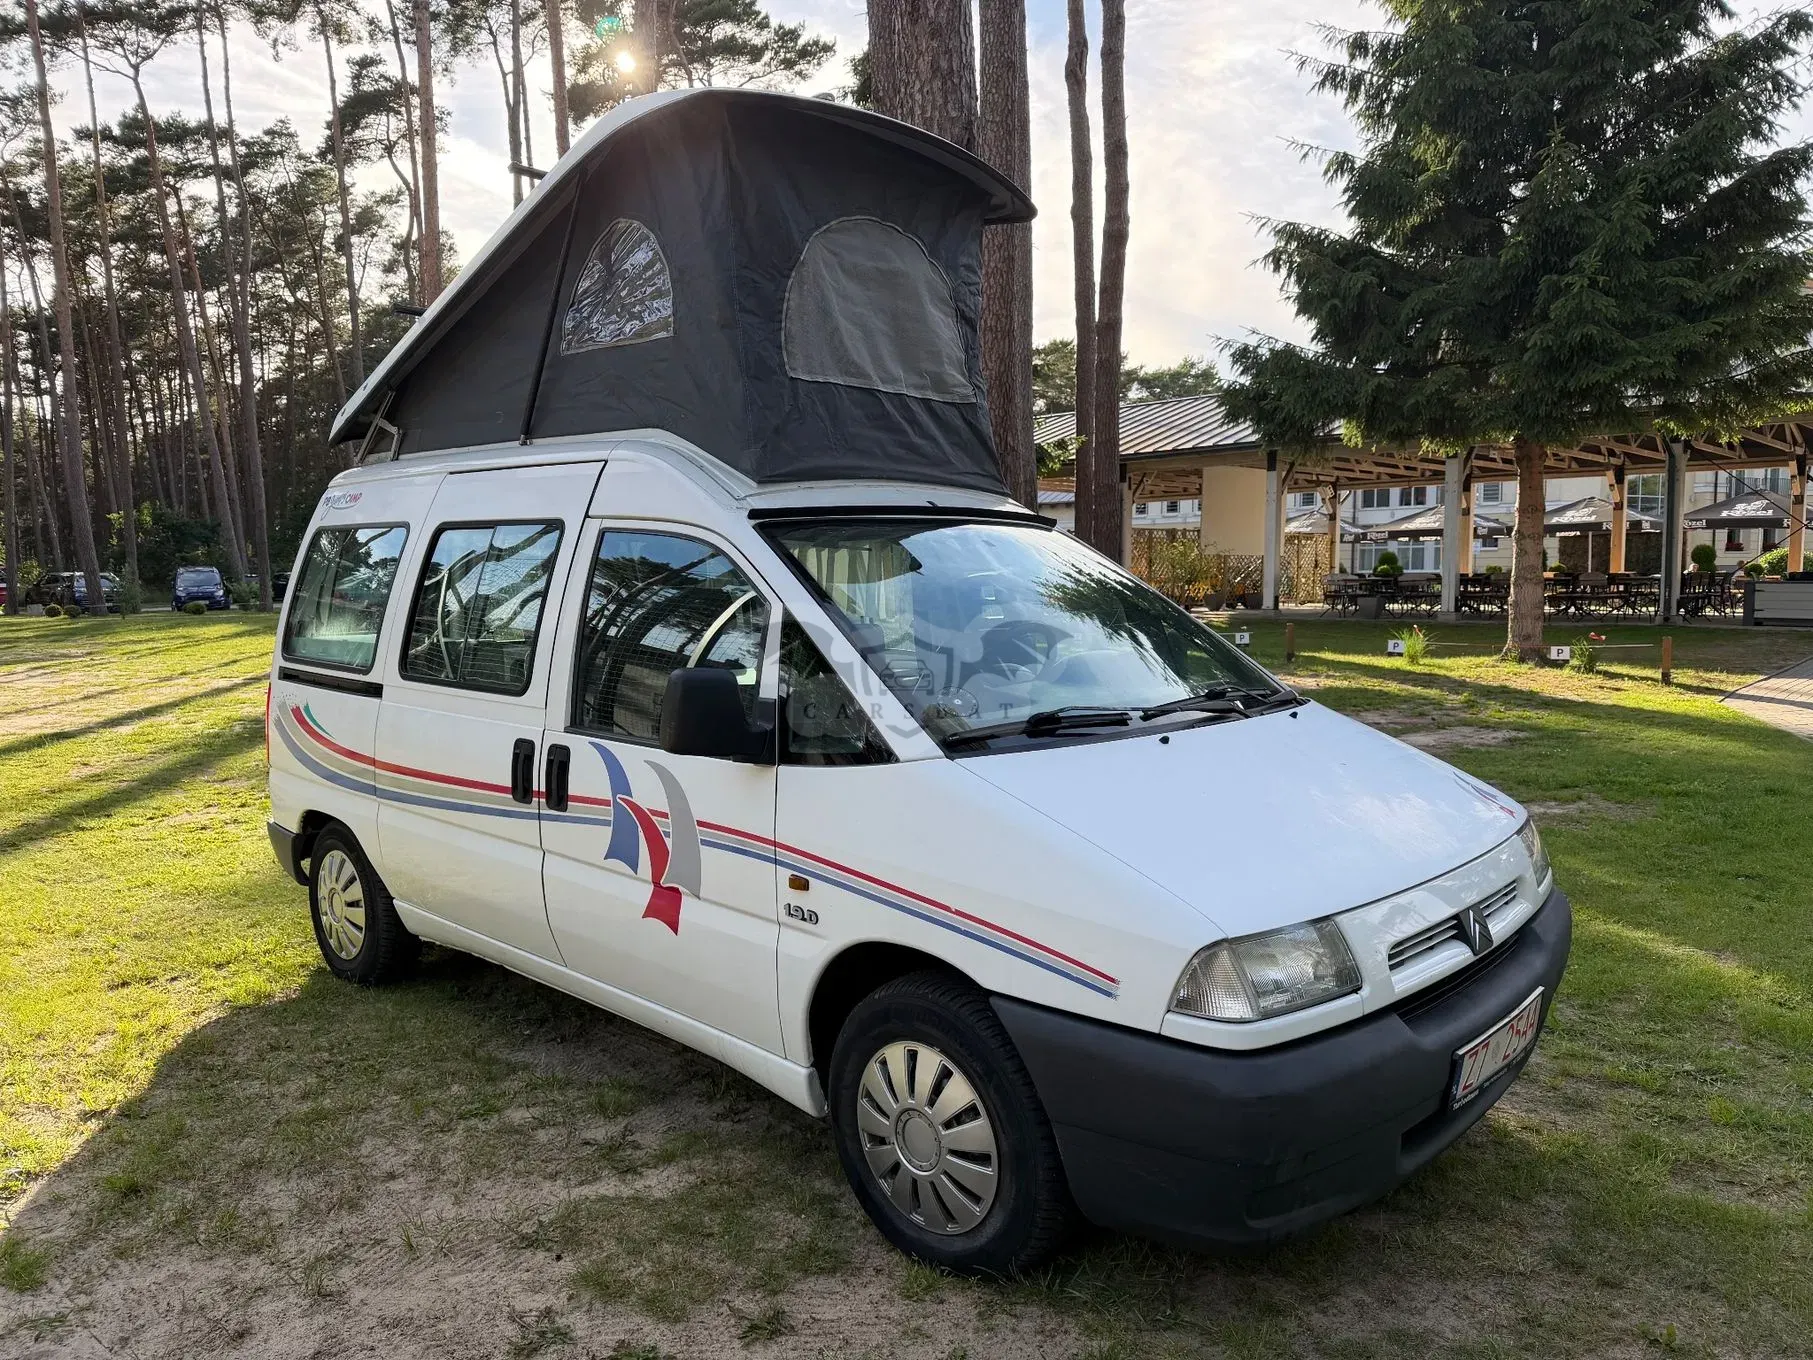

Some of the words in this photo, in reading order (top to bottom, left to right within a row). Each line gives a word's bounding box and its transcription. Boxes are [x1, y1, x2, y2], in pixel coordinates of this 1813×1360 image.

[1239, 634, 1246, 642] P
[1392, 642, 1400, 650] P
[1556, 648, 1564, 657] P
